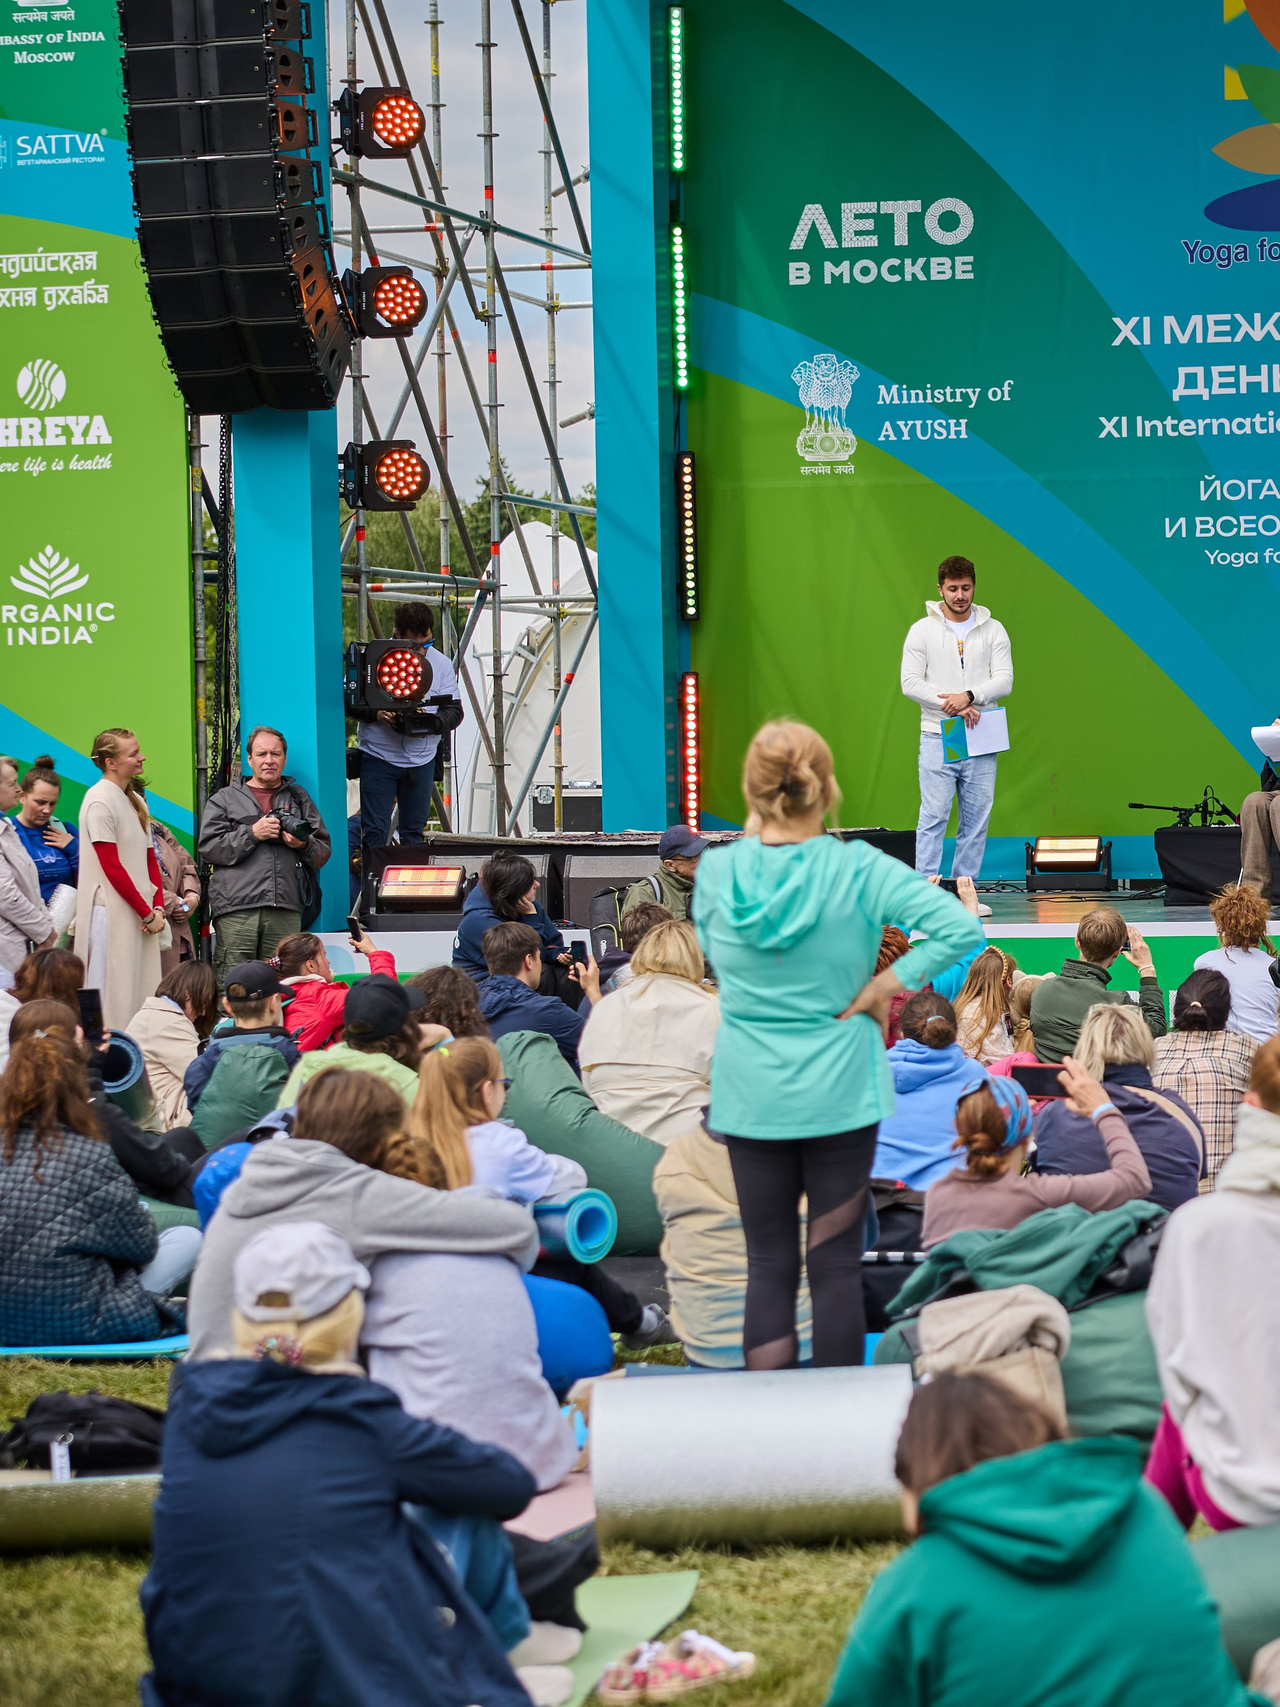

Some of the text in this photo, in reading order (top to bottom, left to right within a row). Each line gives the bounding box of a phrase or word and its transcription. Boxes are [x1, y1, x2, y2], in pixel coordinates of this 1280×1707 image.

[11, 6, 75, 23] सत्यमेव जयते
[45, 32, 64, 44] OF
[66, 29, 106, 43] INDIA
[13, 50, 76, 64] MOSCOW
[788, 197, 975, 250] ЛЕТО
[1180, 236, 1251, 271] Yoga
[788, 255, 975, 286] В МОСКВЕ
[1111, 316, 1151, 347] XI
[876, 379, 1014, 409] Ministry of
[0, 415, 112, 447] HREYA
[877, 418, 968, 441] AYUSH
[1098, 416, 1128, 439] XI
[0, 452, 113, 477] ere life is health
[799, 461, 855, 476] सत्यमेव जयते
[1164, 516, 1187, 539] И
[1204, 549, 1259, 568] Yoga
[1, 602, 116, 624] RGANIC
